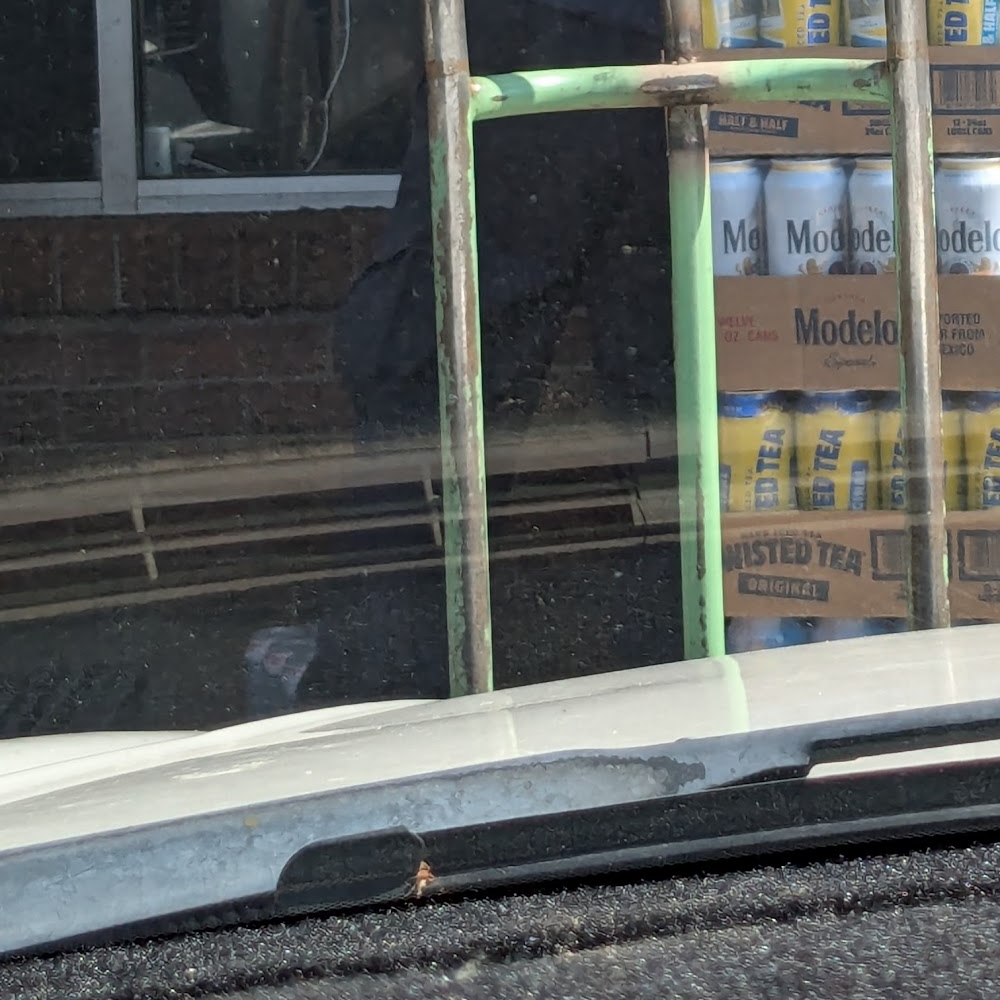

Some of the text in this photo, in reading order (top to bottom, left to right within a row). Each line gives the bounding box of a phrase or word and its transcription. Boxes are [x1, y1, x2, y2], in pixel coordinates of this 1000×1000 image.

[786, 218, 844, 254] Mod
[794, 307, 898, 346] Modelo
[756, 428, 786, 474] TEA
[813, 428, 846, 472] TEA
[724, 537, 863, 577] WISTED TEA
[747, 576, 818, 597] ORIGINAL
